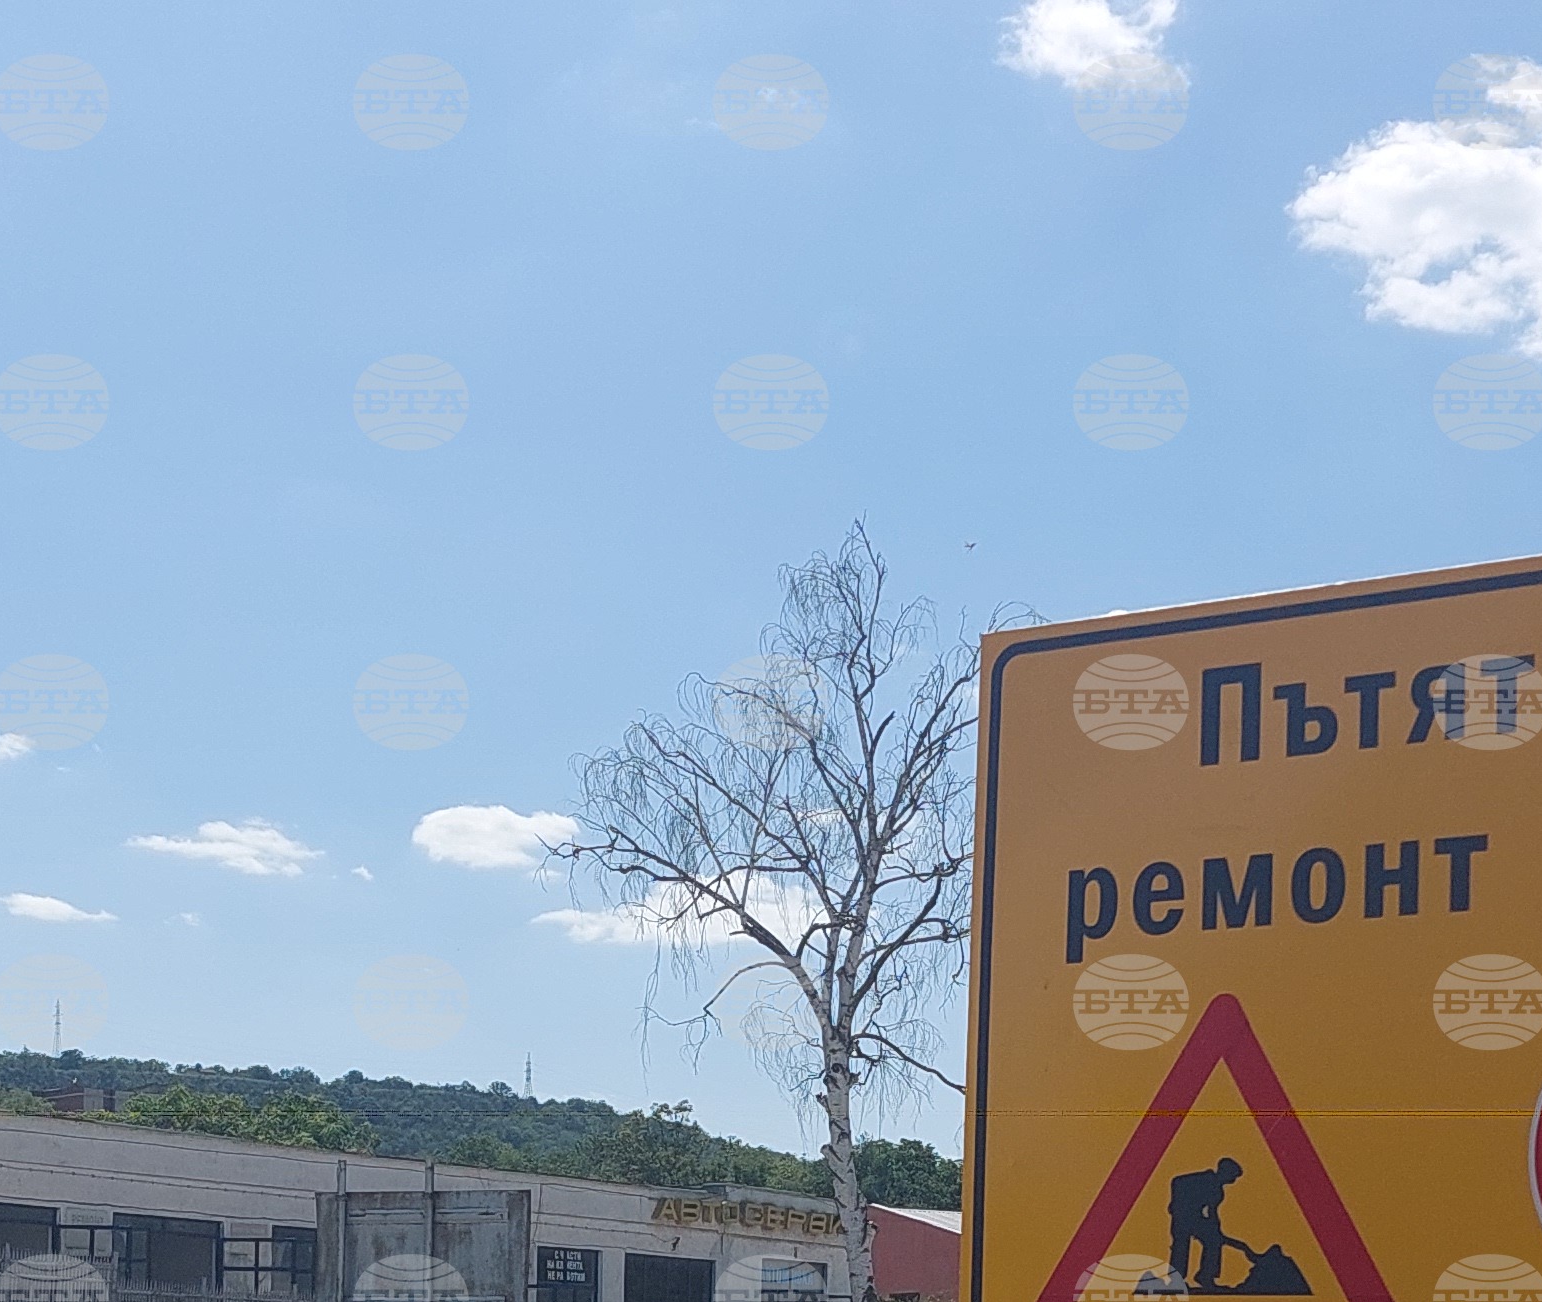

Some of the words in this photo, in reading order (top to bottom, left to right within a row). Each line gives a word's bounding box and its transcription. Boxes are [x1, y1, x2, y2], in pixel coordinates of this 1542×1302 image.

[1200, 654, 1535, 767] Пътят
[1065, 834, 1489, 964] ремонт
[659, 1199, 842, 1236] АВТОСЕРВИ
